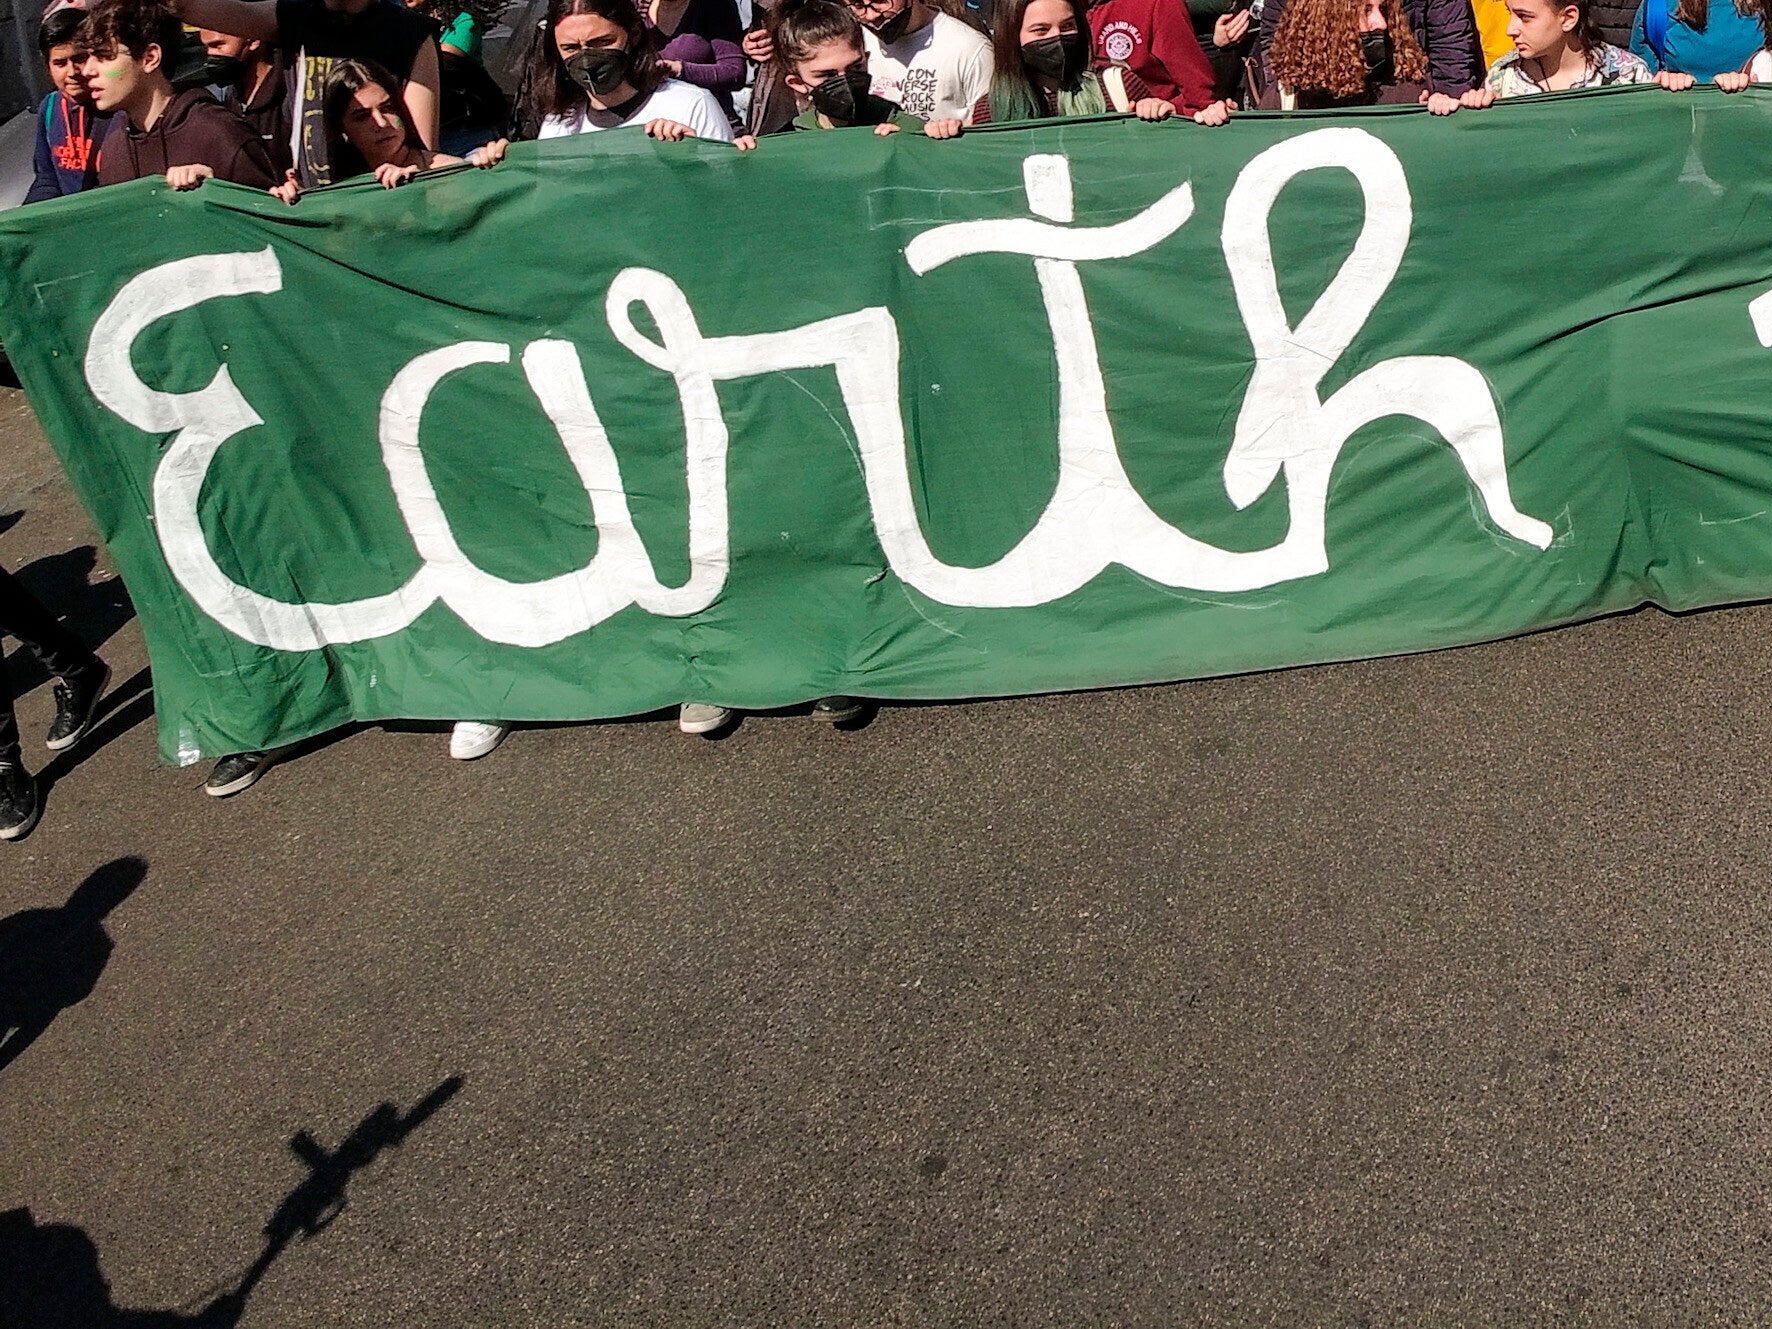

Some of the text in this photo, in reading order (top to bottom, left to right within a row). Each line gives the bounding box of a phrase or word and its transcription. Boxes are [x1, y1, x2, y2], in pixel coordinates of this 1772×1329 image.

[906, 68, 937, 81] CON
[896, 78, 938, 93] VERSE
[901, 92, 935, 104] ROCK
[82, 127, 1555, 652] Earth
